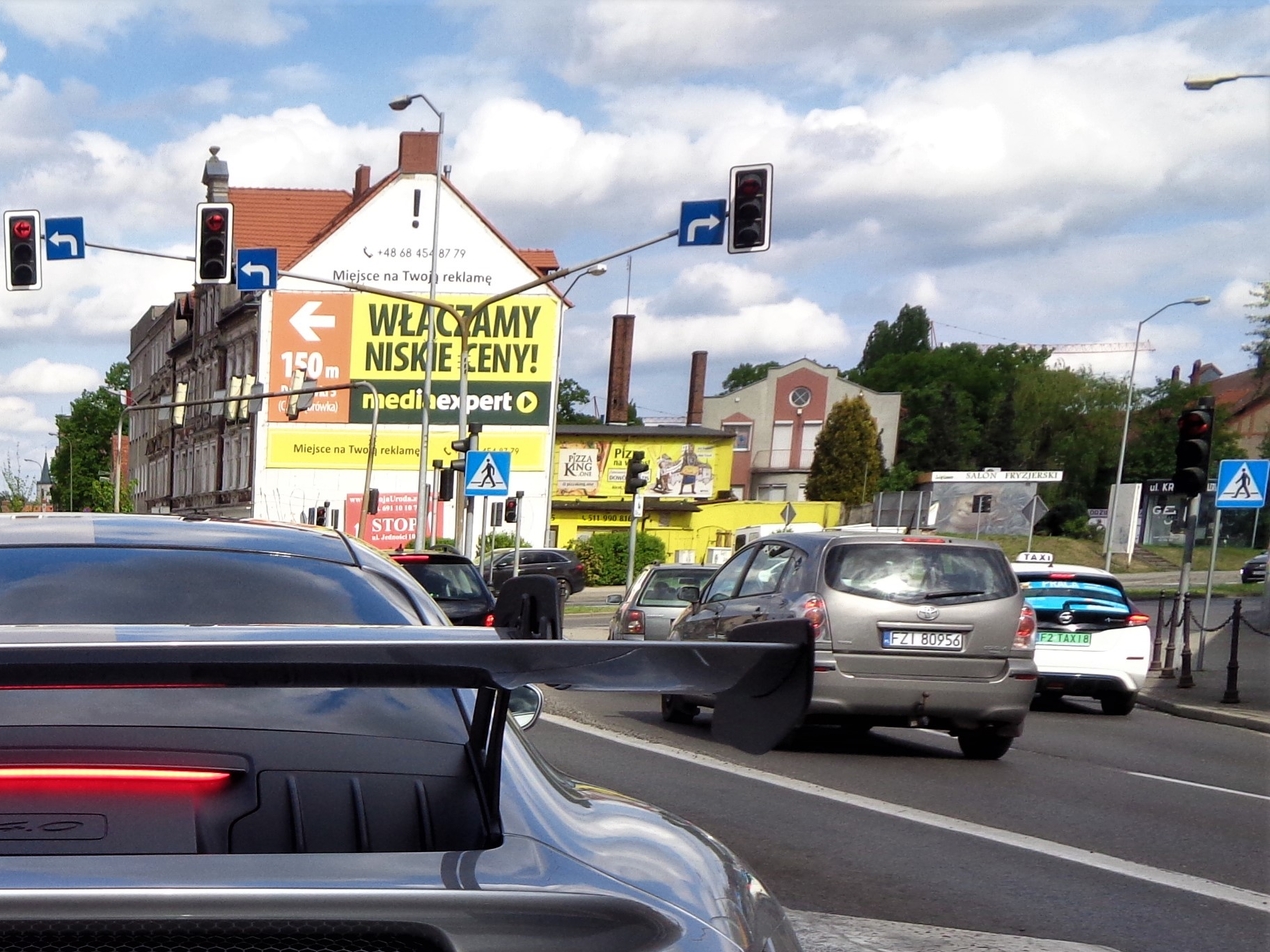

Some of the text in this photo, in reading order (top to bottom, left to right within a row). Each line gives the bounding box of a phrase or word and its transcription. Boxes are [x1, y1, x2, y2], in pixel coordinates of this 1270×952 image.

[378, 247, 397, 258] +48
[399, 247, 412, 258] 68
[438, 248, 450, 259] 87
[453, 248, 466, 259] 79
[333, 270, 380, 283] Miejsce
[383, 272, 399, 281] na
[443, 271, 492, 286] reklamę
[281, 351, 340, 379] 150 m
[365, 341, 539, 374] NISKIE CENY!
[362, 388, 512, 415] mediaexpert
[293, 444, 331, 455] Miejsce
[333, 446, 345, 454] na
[380, 445, 420, 457] reklamę
[1005, 471, 1058, 480] FRYZJERSKI
[1149, 484, 1159, 492] ul.
[371, 517, 418, 532] STOP
[891, 631, 961, 647] FZI 80956
[1040, 633, 1054, 643] F2
